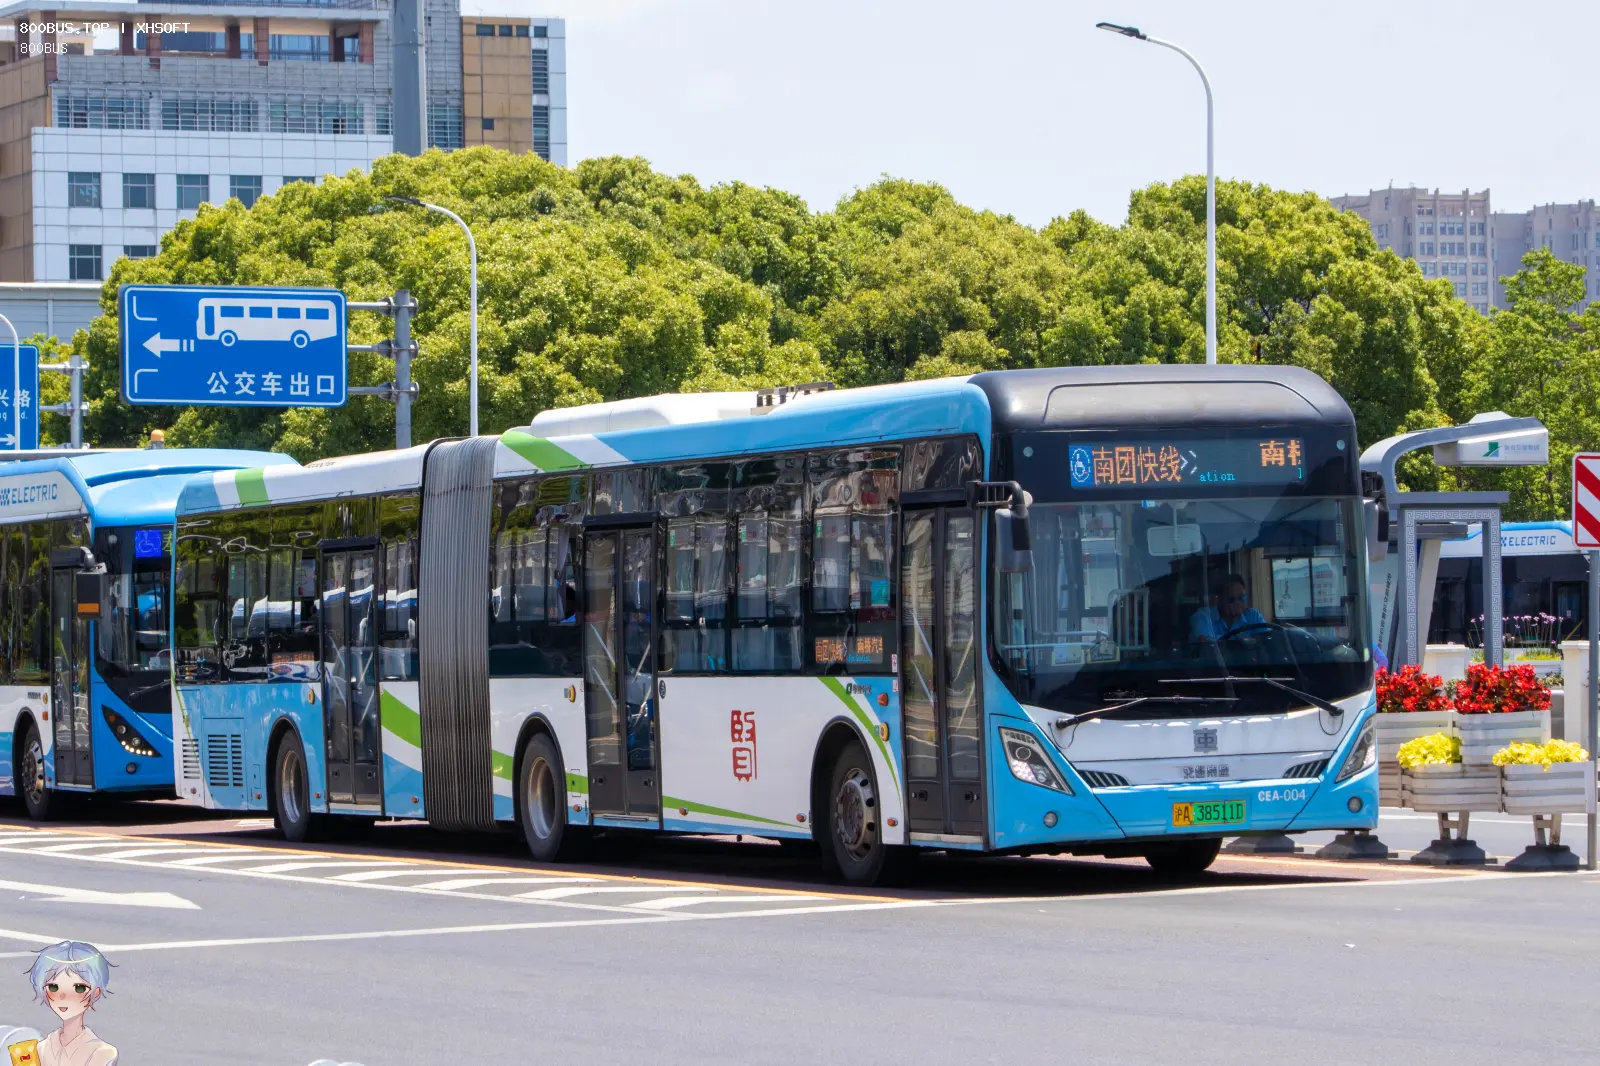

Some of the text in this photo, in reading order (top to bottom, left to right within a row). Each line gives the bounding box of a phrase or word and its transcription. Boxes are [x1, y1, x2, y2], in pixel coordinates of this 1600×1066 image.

[206, 371, 335, 397] 公交车出口
[1091, 445, 1182, 485] 南团快线
[12, 483, 58, 505] ELECTRIC
[1508, 535, 1557, 547] ELECTRIC
[1258, 788, 1306, 803] CEA-004
[1196, 803, 1244, 822] 38511D
